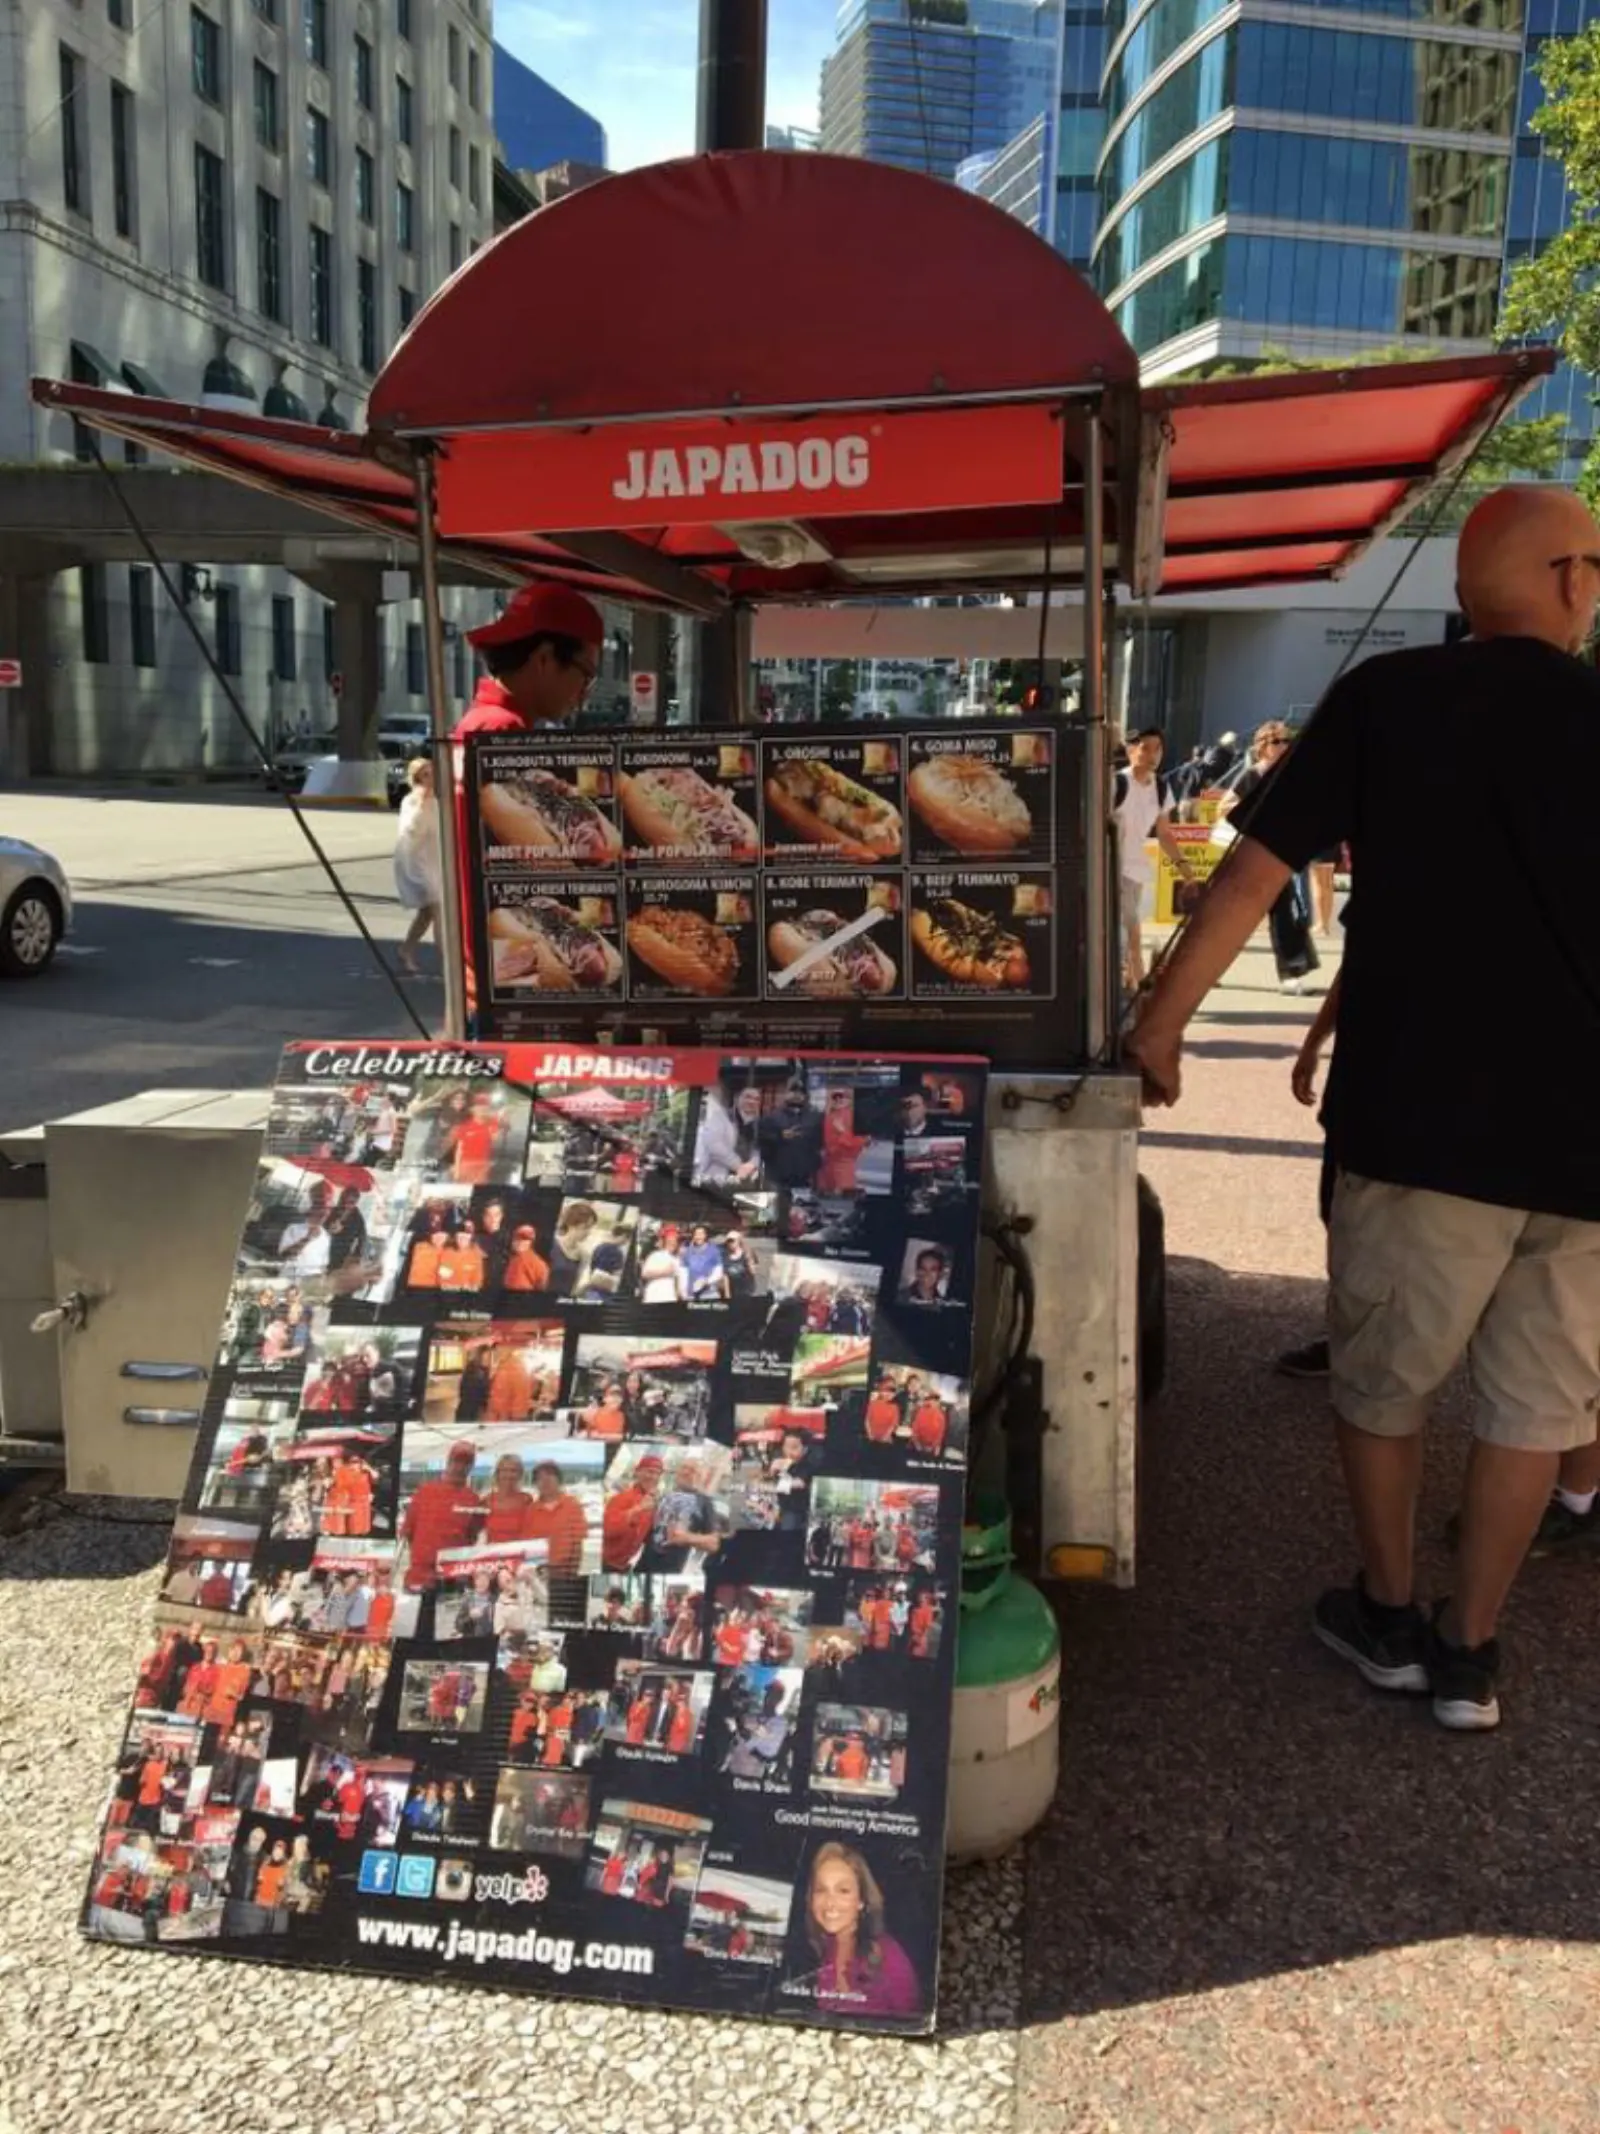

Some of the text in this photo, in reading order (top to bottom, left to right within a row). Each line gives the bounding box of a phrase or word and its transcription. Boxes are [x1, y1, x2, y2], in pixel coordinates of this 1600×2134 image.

[612, 435, 870, 500] JAPADOG
[926, 739, 962, 752] GOMA
[965, 738, 998, 751] MISO
[780, 876, 809, 889] KOBE
[813, 875, 873, 888] TERIMAYO
[926, 874, 952, 886] BEEF
[958, 872, 1019, 886] TERIMAYO
[305, 1048, 674, 1080] Celebrities JAPADOG
[774, 1808, 921, 1837] Good morning America
[474, 1873, 525, 1905] yelp
[357, 1917, 655, 1974] www.japadog.com
